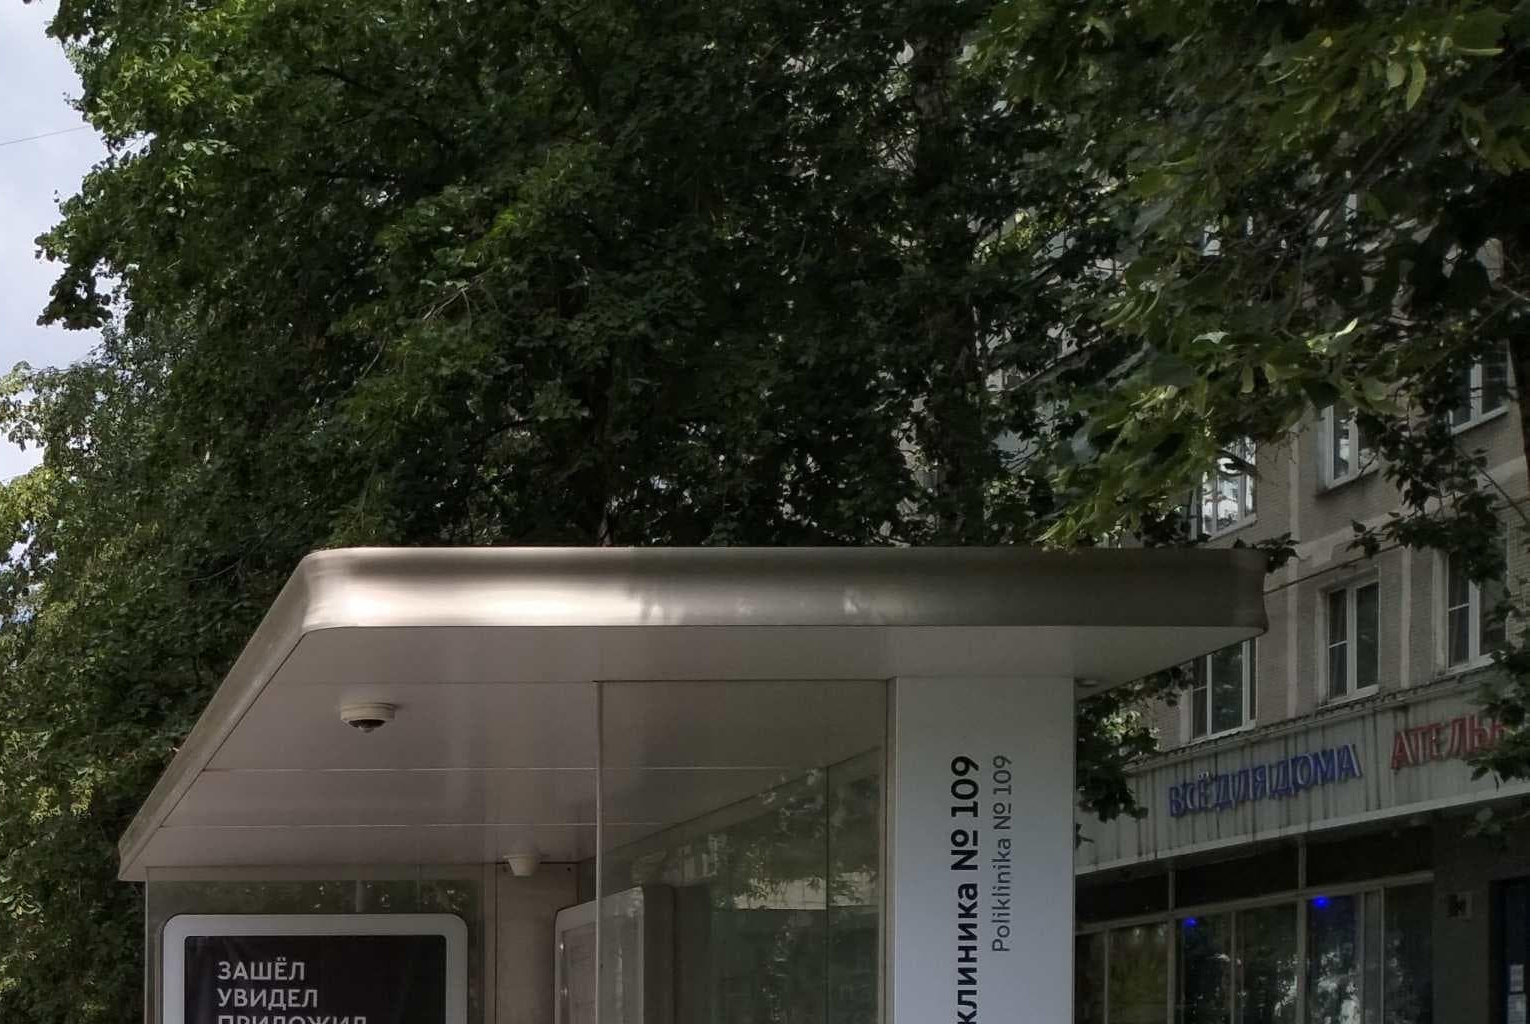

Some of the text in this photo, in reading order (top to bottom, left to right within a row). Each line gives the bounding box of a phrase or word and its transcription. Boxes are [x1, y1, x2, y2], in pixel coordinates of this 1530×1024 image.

[951, 756, 979, 817] 109
[993, 755, 1012, 795] 109
[1169, 743, 1363, 818] ВСЁ ДЛЯ ДОМА
[991, 838, 1011, 952] Poliklinika
[217, 957, 306, 981] ЗАШЁЛ
[217, 988, 319, 1011] УВИДЕЛ
